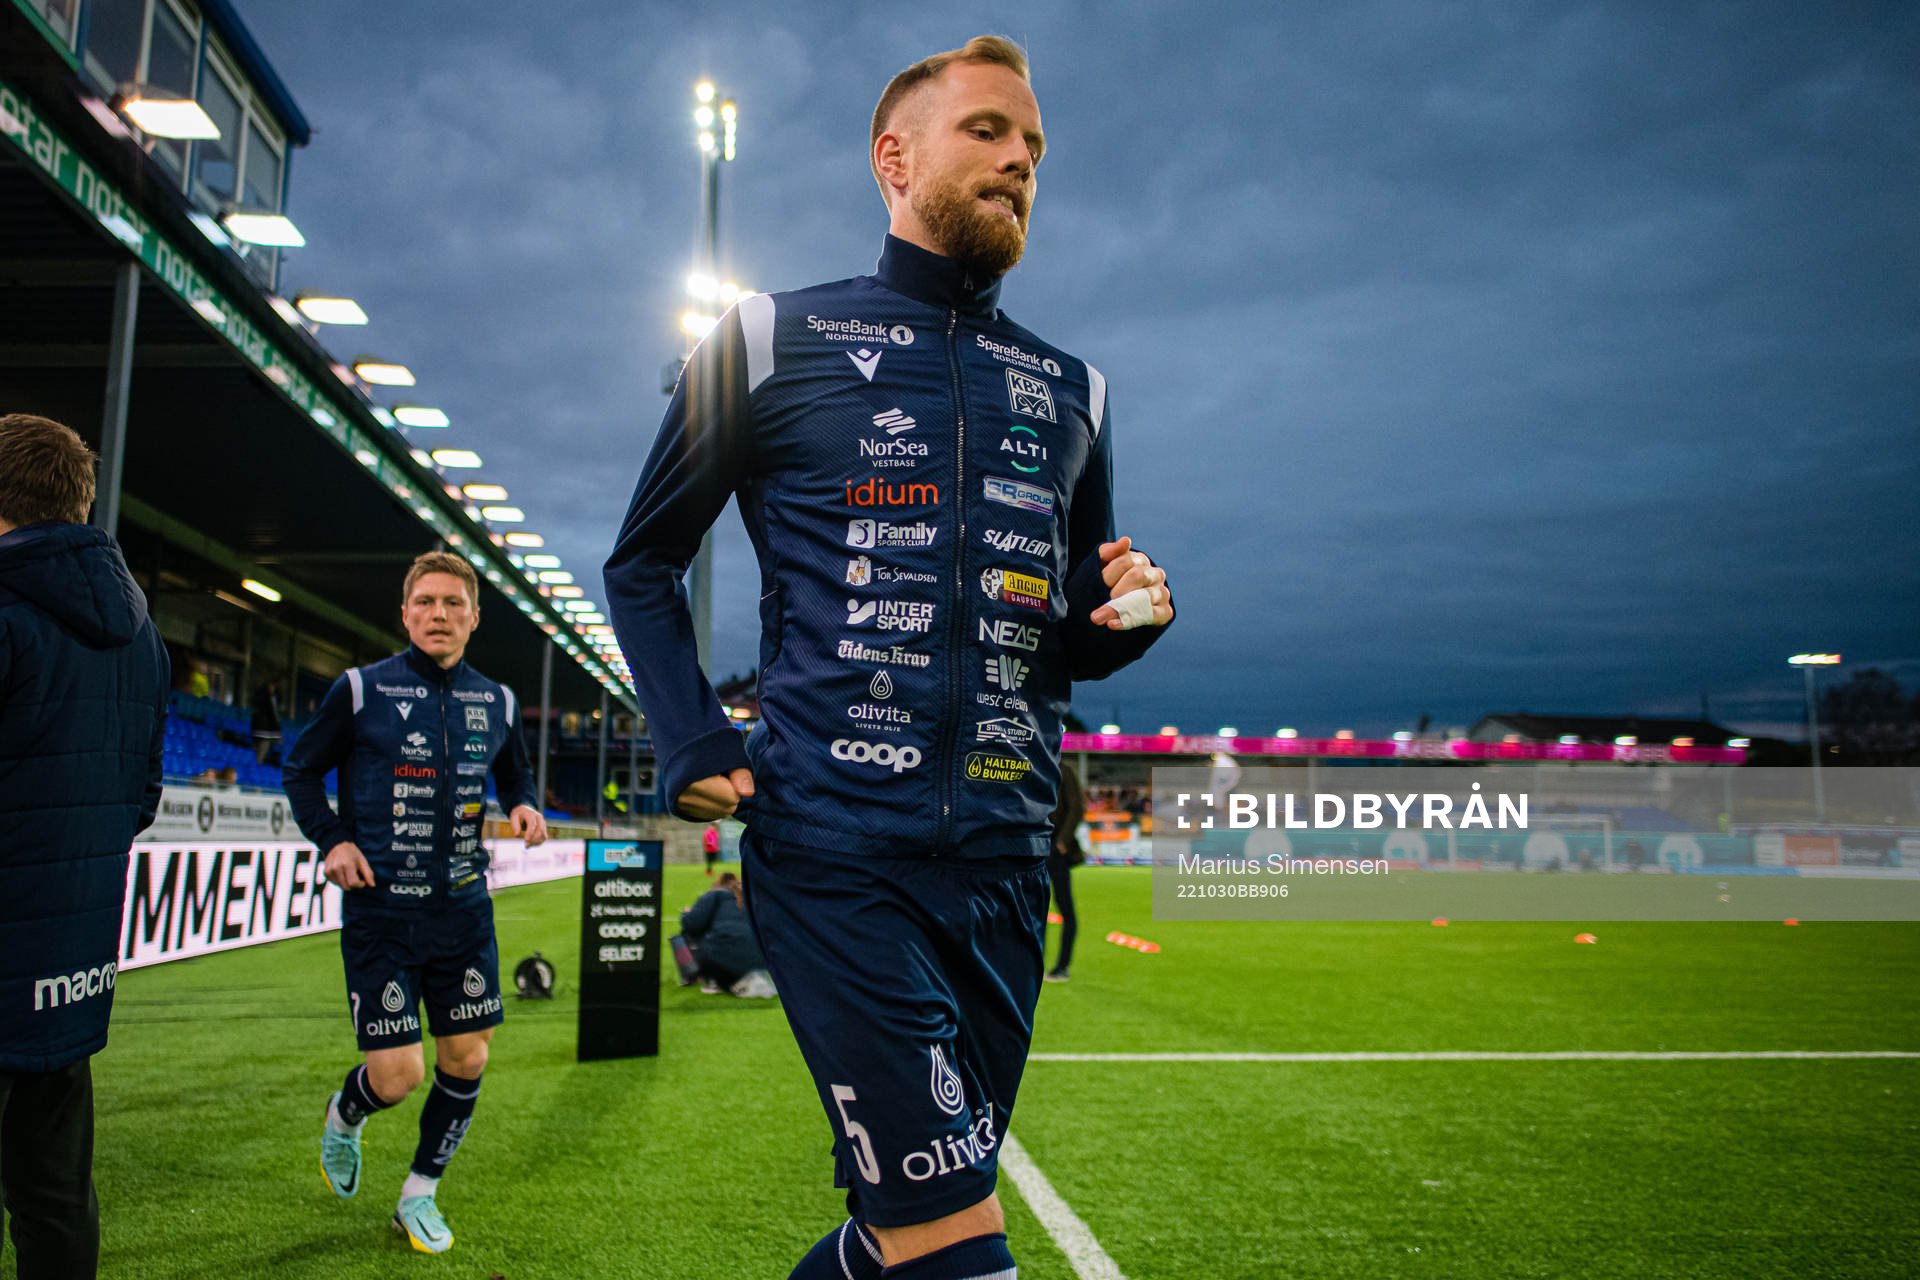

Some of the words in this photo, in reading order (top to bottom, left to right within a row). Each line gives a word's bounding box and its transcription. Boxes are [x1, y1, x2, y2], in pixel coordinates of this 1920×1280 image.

[807, 315, 887, 337] SpareBank
[825, 332, 889, 344] NORDMØRE
[976, 334, 1041, 366] SpareBank
[858, 438, 929, 457] NorSea
[1000, 438, 1047, 460] ALTI
[872, 459, 916, 468] VESTBASE
[846, 477, 939, 506] idium
[1017, 490, 1052, 505] GROUP
[877, 521, 938, 546] Family
[877, 539, 906, 547] SPORTS
[907, 539, 926, 547] CLUB
[878, 599, 934, 618] INTER
[1011, 594, 1041, 607] GAUPSET
[876, 614, 933, 633] SPORT
[978, 616, 1042, 652] NEAS
[837, 639, 889, 662] Tidens
[888, 645, 931, 668] Krav
[976, 691, 1004, 707] west
[847, 703, 912, 724] olivita
[855, 722, 881, 730] LIVETS
[401, 745, 432, 757] NorSea
[464, 743, 488, 752] ALTI
[830, 738, 922, 773] coop
[393, 762, 437, 778] idium
[408, 784, 435, 798] Family
[408, 822, 433, 831] INTER
[408, 829, 433, 837] SPORT
[389, 883, 432, 898] coop
[594, 877, 653, 897] altibox
[599, 921, 646, 940] coop
[599, 944, 645, 962] SELECT
[450, 994, 502, 1022] olivita
[830, 1083, 881, 1185] 5
